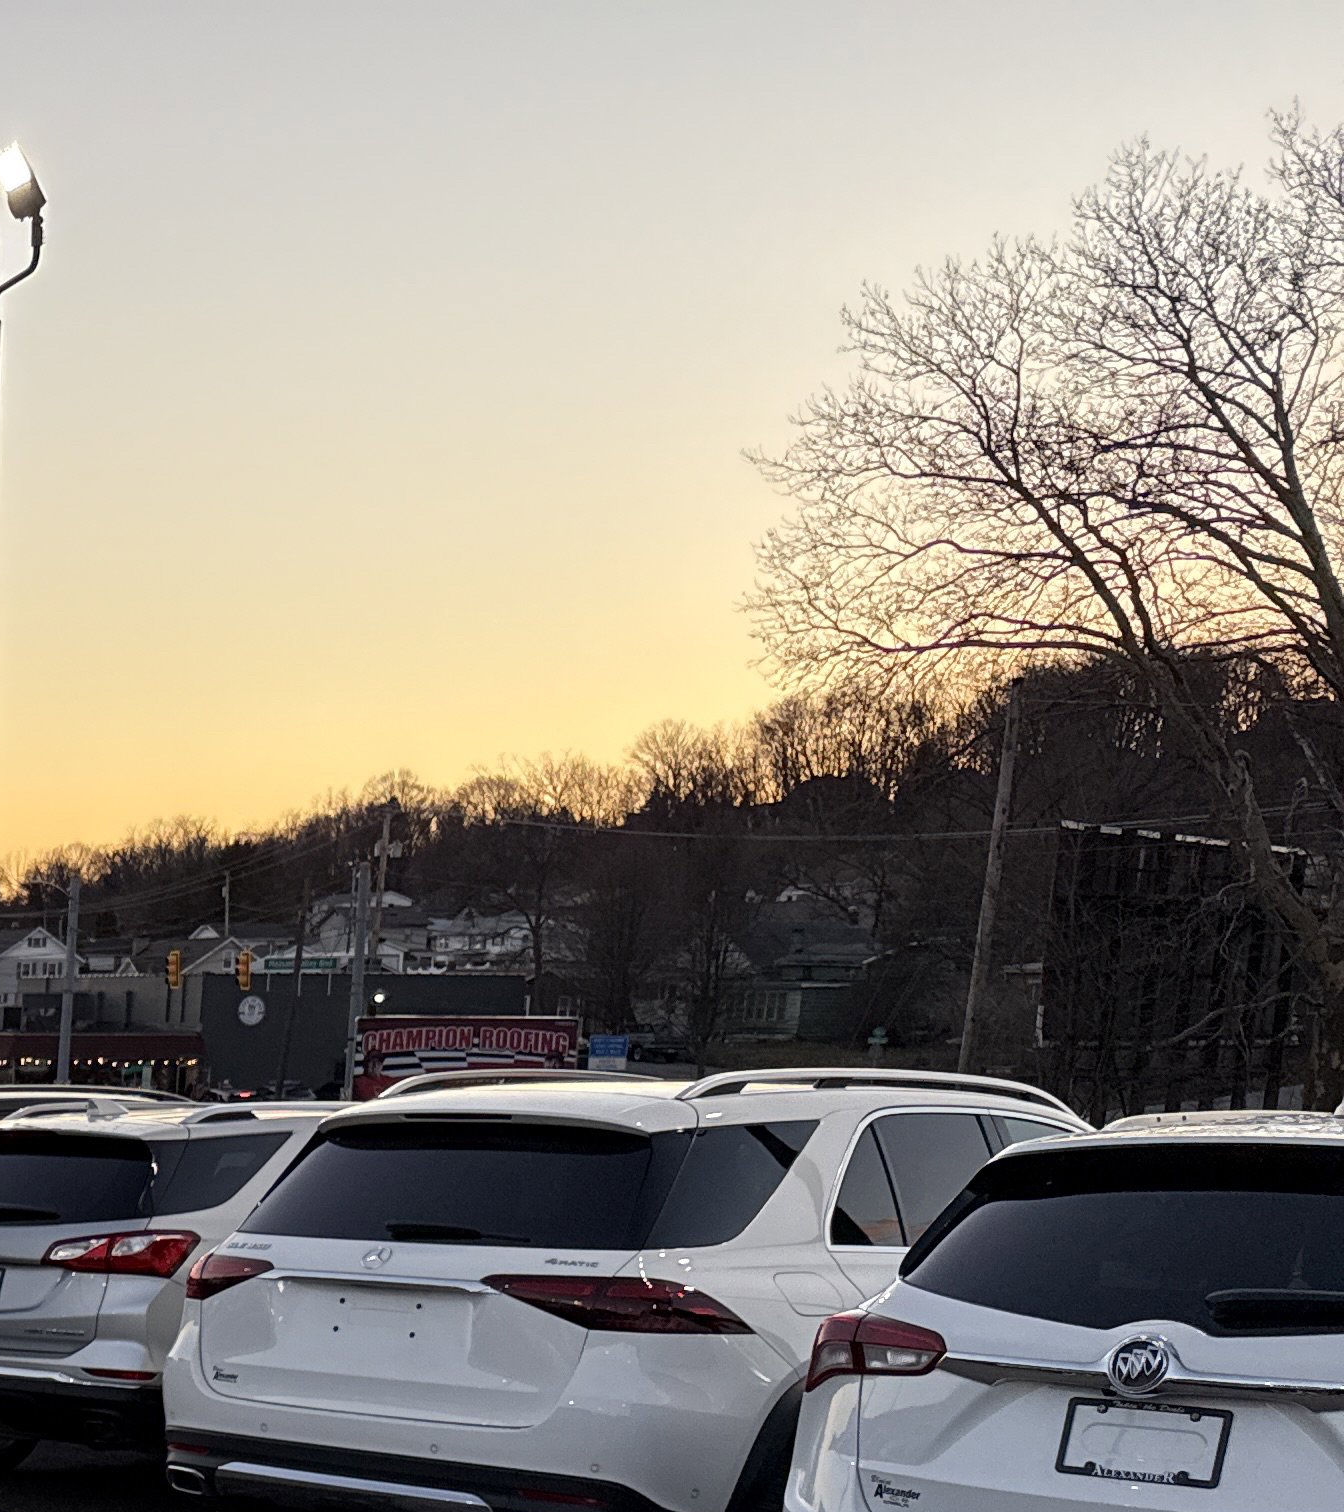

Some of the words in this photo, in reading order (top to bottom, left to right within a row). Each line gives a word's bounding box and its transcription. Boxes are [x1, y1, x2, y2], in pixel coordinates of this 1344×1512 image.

[363, 1026, 474, 1053] CHAMPION
[480, 1029, 570, 1054] ROOFING
[874, 1483, 921, 1500] Alexander
